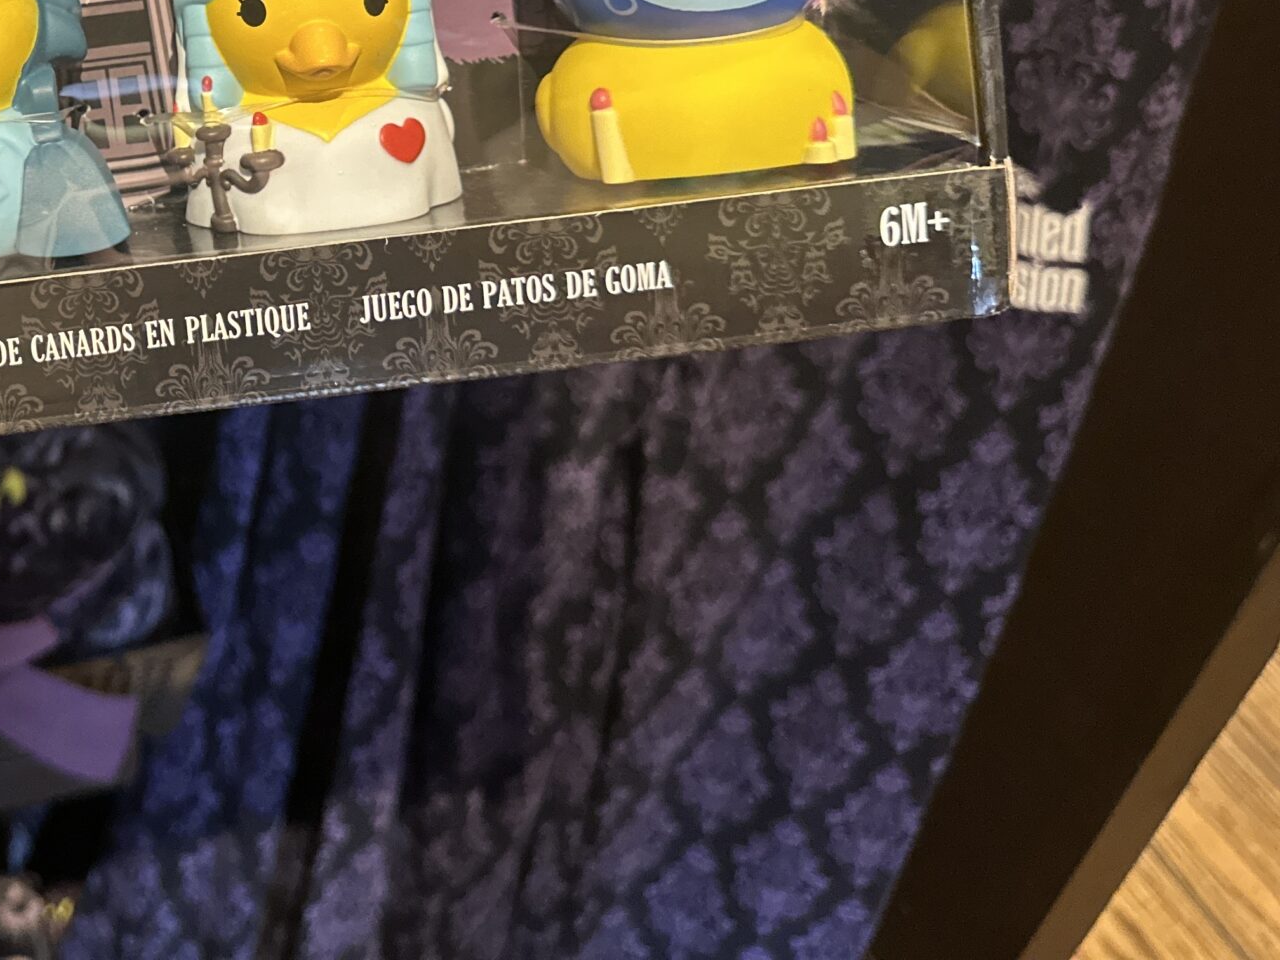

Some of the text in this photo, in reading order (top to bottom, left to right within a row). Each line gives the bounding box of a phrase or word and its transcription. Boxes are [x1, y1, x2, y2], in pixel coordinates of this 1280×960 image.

[879, 201, 951, 247] 6M+
[359, 259, 675, 324] JUEGO DE PATOS DE GOMA
[30, 323, 136, 363] CANARDS
[144, 318, 176, 349] EN
[184, 302, 312, 342] PLASTIQUE
